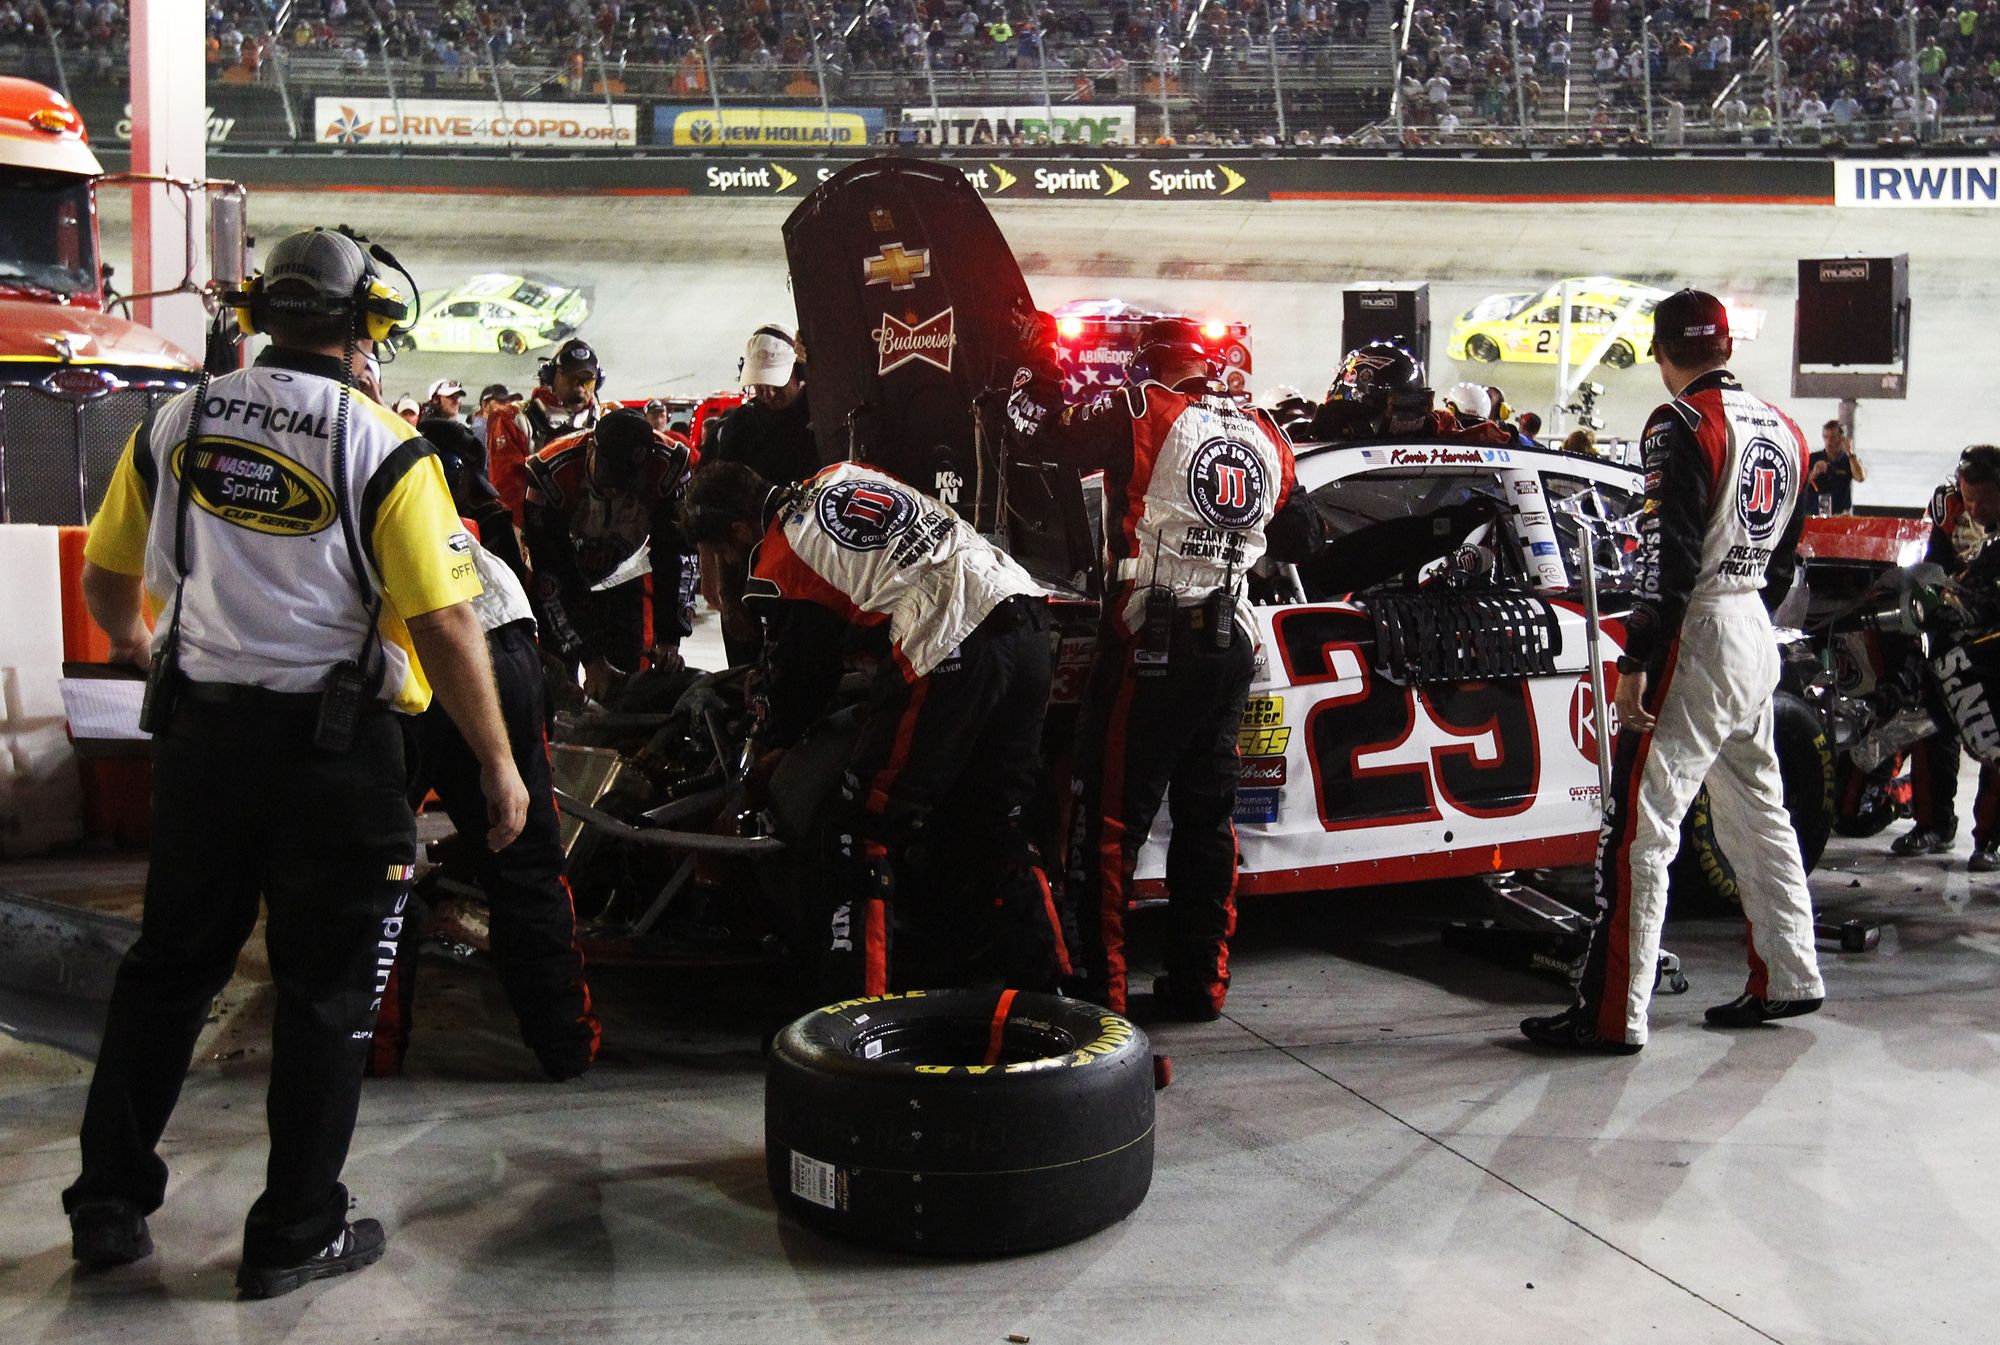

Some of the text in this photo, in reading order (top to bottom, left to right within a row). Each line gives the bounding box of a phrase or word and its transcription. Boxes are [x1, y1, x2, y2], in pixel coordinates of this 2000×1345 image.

[379, 115, 630, 141] DRIVE4COPD.ORG
[720, 126, 851, 142] NEW HOLLAND
[706, 166, 770, 191] Sprint
[1034, 168, 1101, 194] Sprint
[1149, 169, 1216, 195] Sprint
[1855, 167, 1997, 200] IRWIN
[871, 326, 957, 355] Budweiser
[203, 396, 330, 440] OFFICIAL
[214, 454, 275, 482] NASCAR
[1197, 443, 1229, 482] JIMMY
[221, 476, 280, 504] Sprint
[222, 507, 258, 521] CUP
[825, 498, 858, 541] JIMMY
[1240, 711, 1281, 724] eter
[1243, 700, 1274, 713] uto
[1272, 606, 1541, 833] 29
[1237, 728, 1291, 756] EGS
[1569, 786, 1601, 796] ODYSS
[821, 989, 927, 1015] EAGLE
